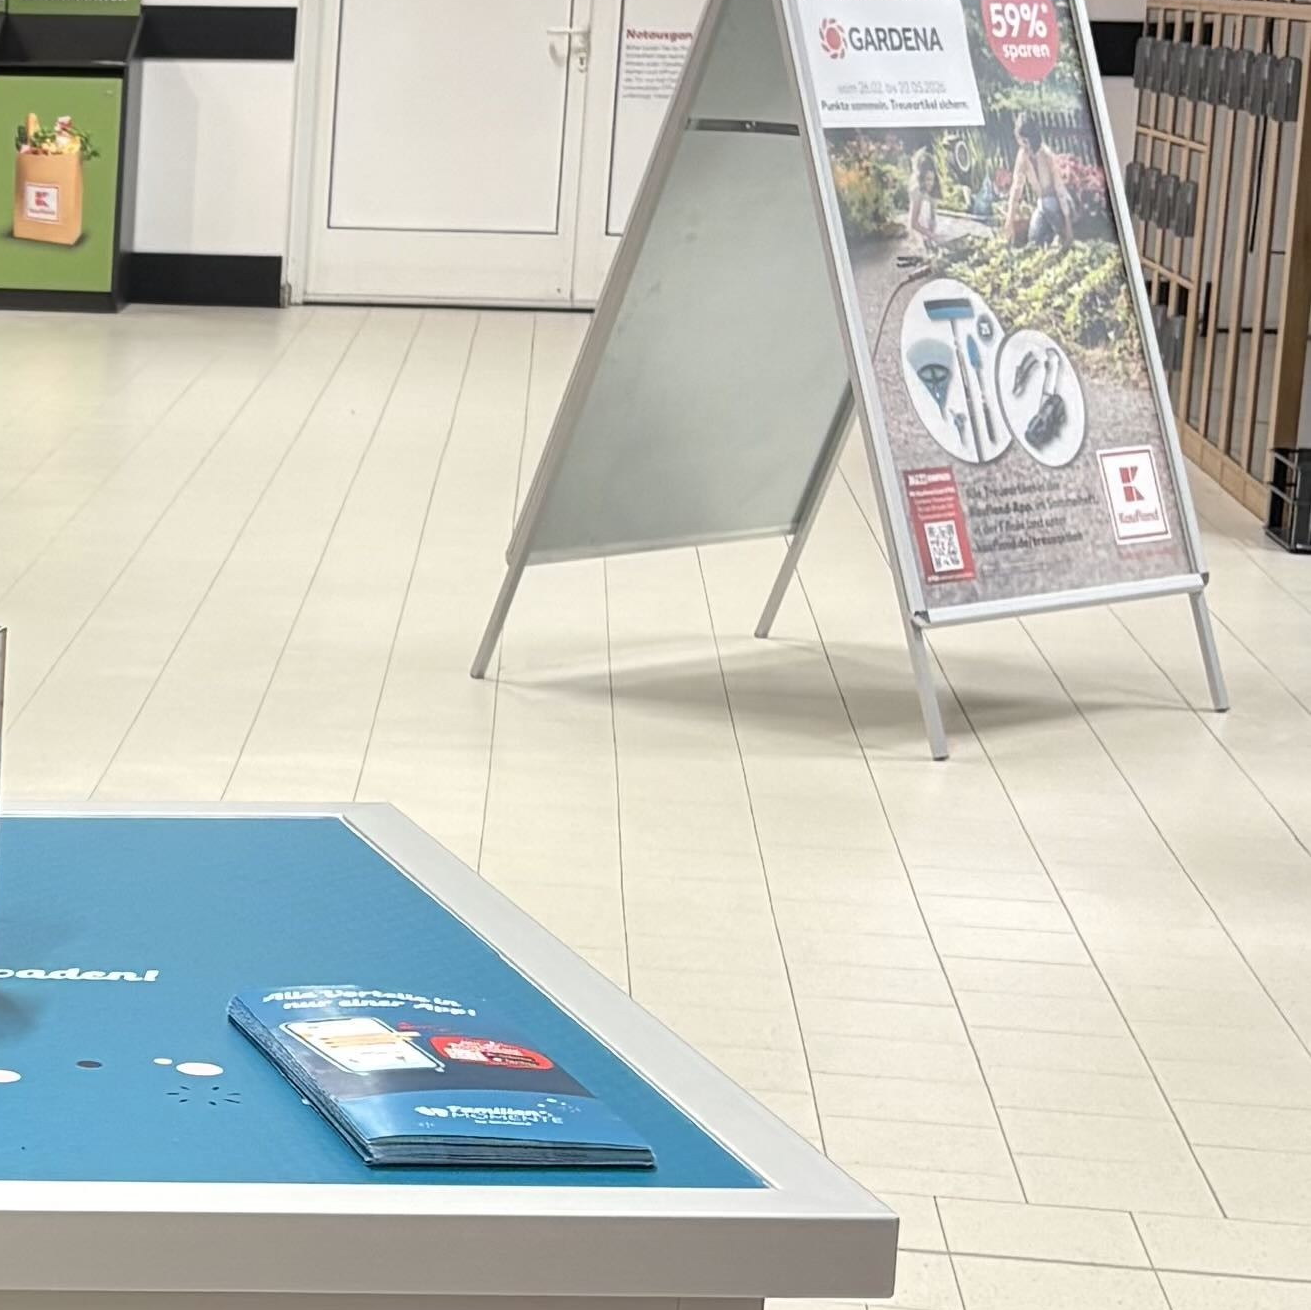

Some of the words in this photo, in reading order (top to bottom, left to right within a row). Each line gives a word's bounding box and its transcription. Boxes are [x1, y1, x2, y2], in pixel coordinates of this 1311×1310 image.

[848, 26, 944, 52] GARDENA
[1002, 42, 1050, 62] sparen
[1117, 509, 1160, 525] Kaufland
